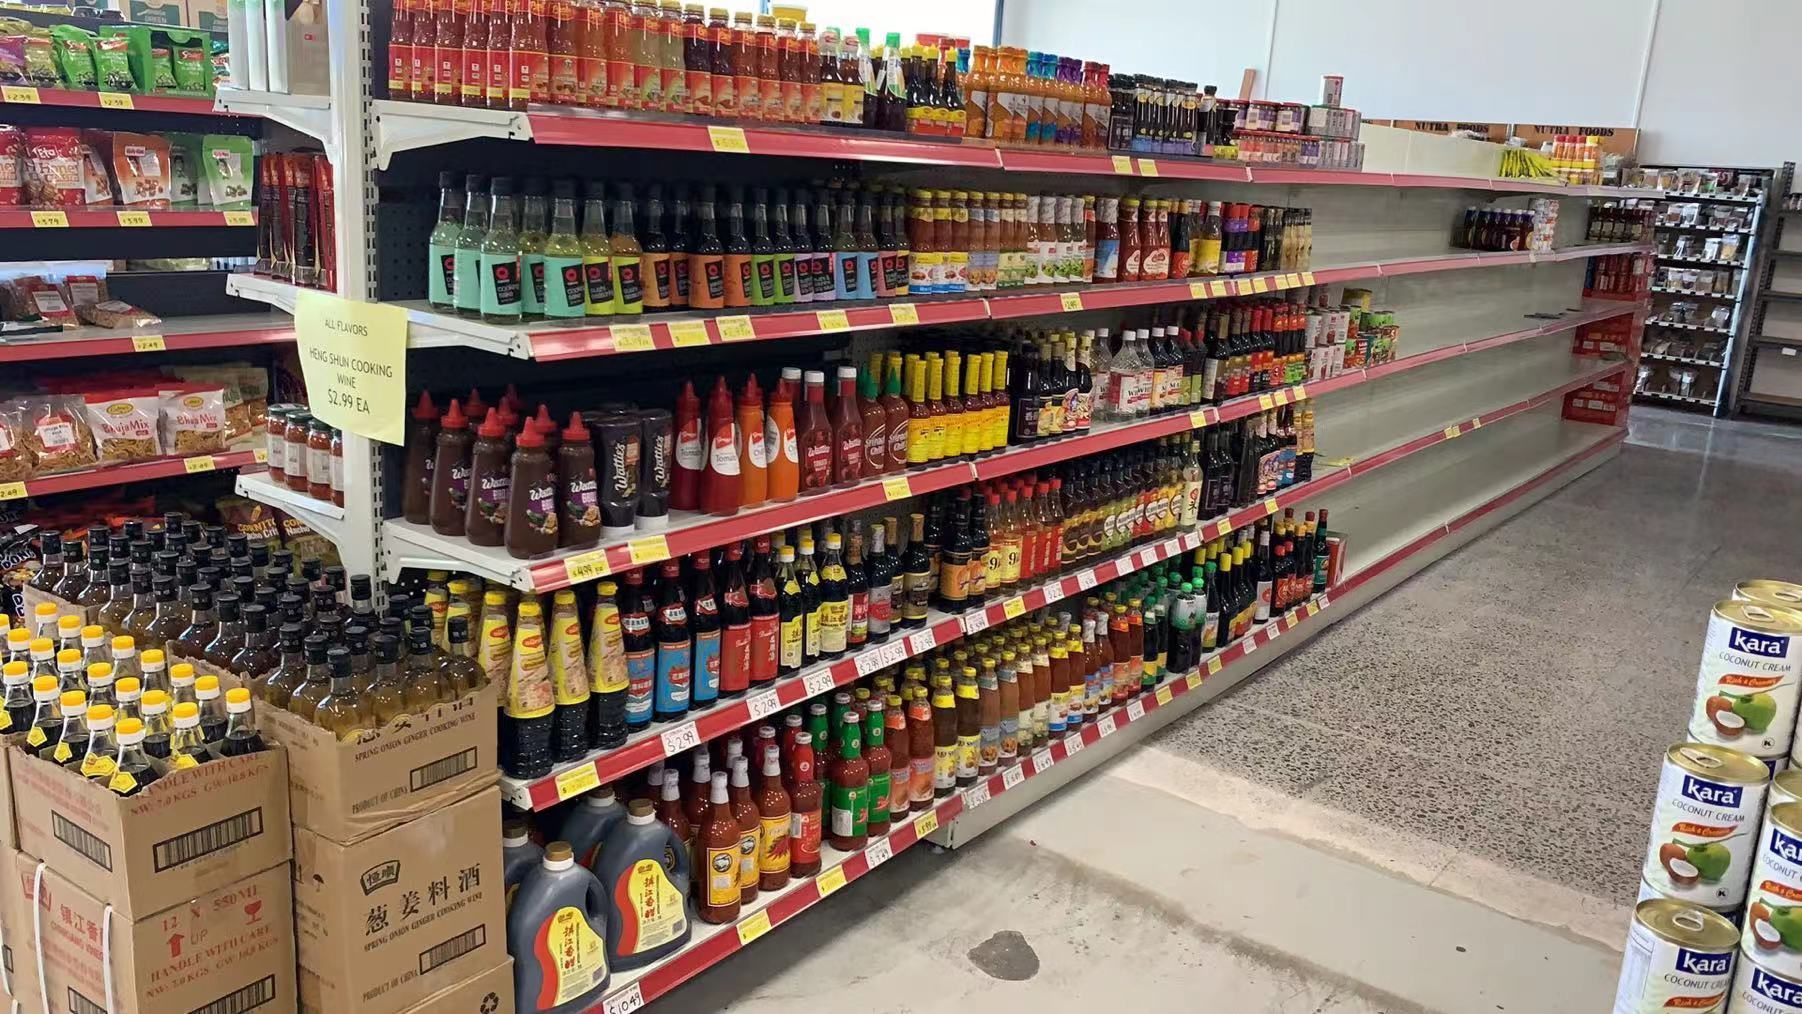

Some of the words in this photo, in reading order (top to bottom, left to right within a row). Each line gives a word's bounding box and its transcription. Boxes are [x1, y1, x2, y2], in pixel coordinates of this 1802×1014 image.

[1414, 121, 1449, 132] NUTRA
[1534, 125, 1570, 135] NUTRA
[1578, 126, 1615, 137] FOODS
[325, 319, 335, 330] ALL
[337, 320, 368, 337] FLAVORS
[309, 347, 328, 363] HENG
[329, 353, 349, 368] SHUN
[351, 359, 393, 378] COOKING
[337, 373, 356, 389] WINE
[328, 388, 353, 409] $2.99
[356, 397, 370, 414] EA
[1734, 630, 1781, 654] kara
[1719, 651, 1760, 669] COCONUT
[1762, 662, 1791, 672] CREAM
[355, 748, 379, 763] SPRING
[380, 739, 401, 753] ONION
[404, 729, 428, 745] GINGER
[429, 719, 459, 736] COOKING
[460, 712, 477, 724] WINE
[1687, 778, 1734, 804] kara
[1672, 798, 1713, 818] COCONUT
[1716, 812, 1745, 822] CREAM
[365, 862, 481, 937] 葱姜料酒
[163, 916, 178, 932] 12
[364, 937, 388, 952] SPRING
[389, 926, 410, 940] ONION
[411, 914, 436, 930] GINGER
[437, 899, 466, 918] COOKING
[467, 891, 483, 903] WINE
[190, 928, 208, 945] UP
[151, 952, 201, 982] HANDLE
[205, 936, 239, 957] WITH
[1683, 952, 1726, 974] kara
[1664, 973, 1709, 990] COCONUT
